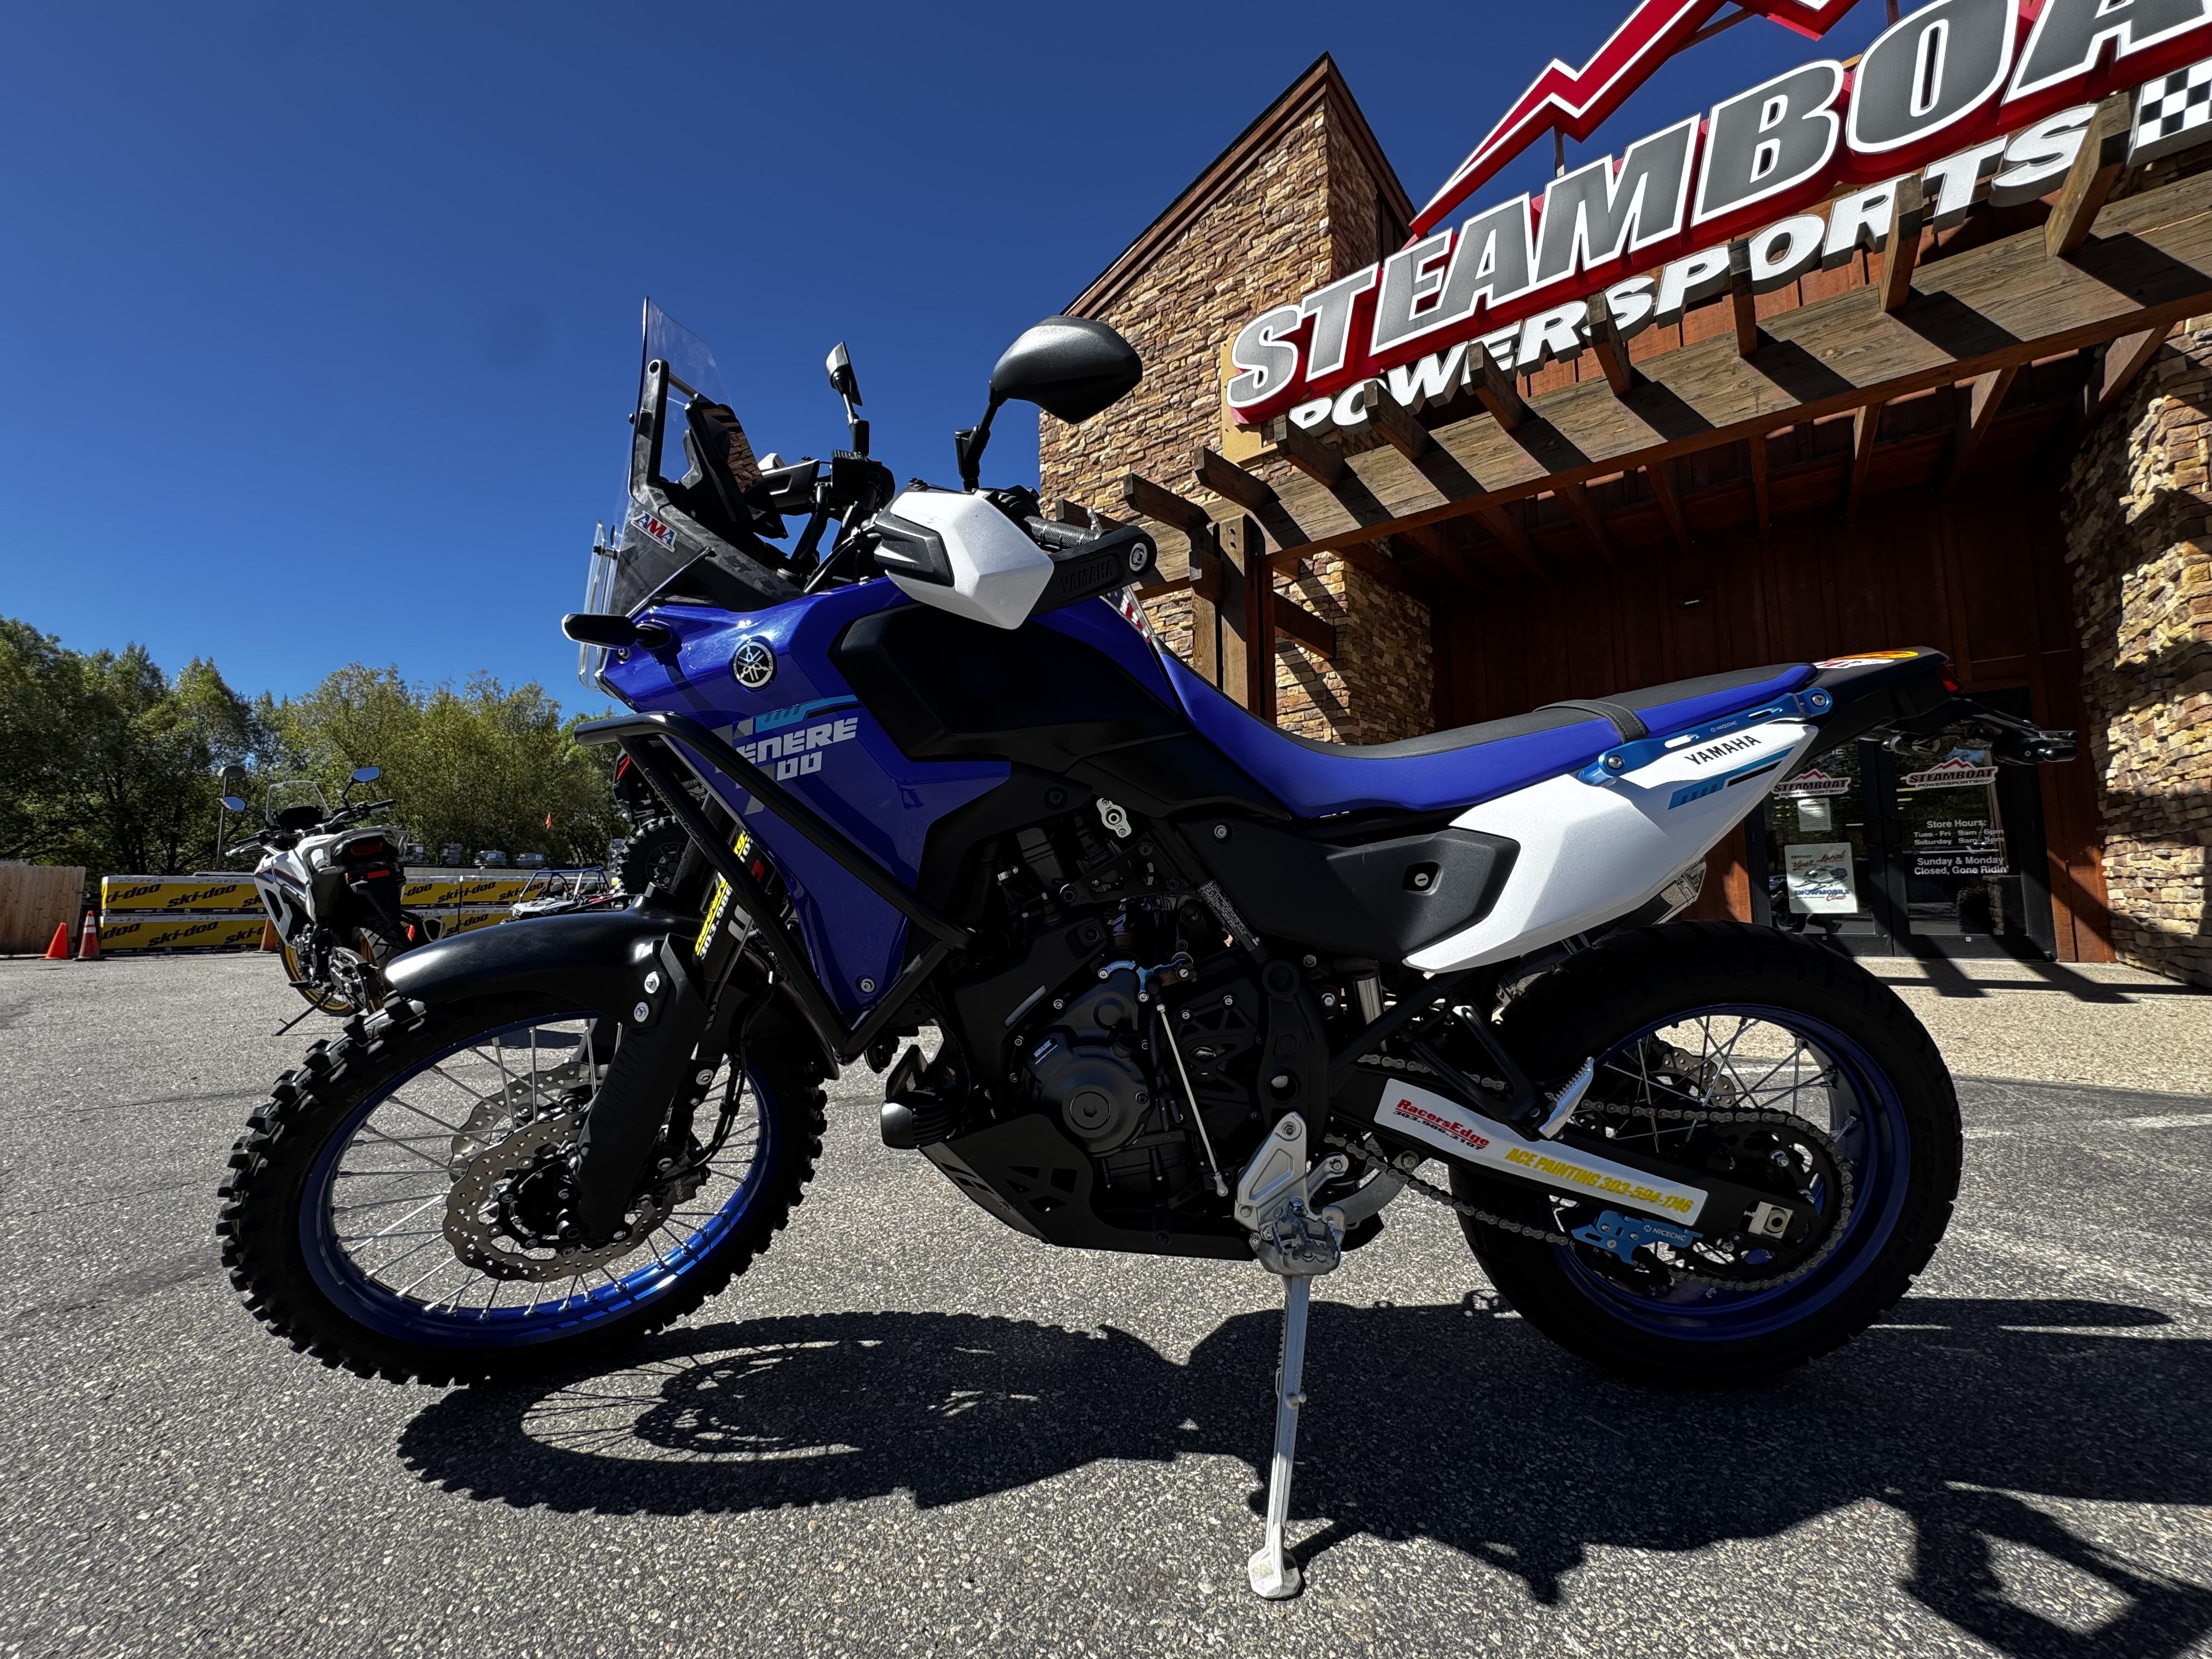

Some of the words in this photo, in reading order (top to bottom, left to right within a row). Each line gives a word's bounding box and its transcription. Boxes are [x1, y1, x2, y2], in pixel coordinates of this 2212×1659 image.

[633, 512, 674, 547] AMA
[1060, 560, 1113, 594] YAMAHA
[735, 717, 858, 764] ENERE
[1684, 735, 1762, 765] YAMAHA
[776, 751, 823, 781] 00
[1910, 768, 1996, 785] STEAMBOAT
[1774, 780, 1848, 793] STEAMBOAT
[1917, 780, 1979, 788] POWERSPORTS
[1914, 867, 1950, 875] Closed,
[1980, 865, 2009, 873] Ridin'
[1917, 857, 1953, 866] Sunday
[1965, 856, 2004, 865] Monday
[105, 884, 161, 904] ki-doo
[167, 884, 237, 907] ski-doo
[147, 922, 218, 947] ski-doo
[1393, 1110, 1486, 1150] 303.986.2107
[1396, 1099, 1489, 1147] RacersEdge
[674, 1178, 684, 1200] embo
[1504, 1148, 1538, 1167] ACE
[1533, 1158, 1602, 1186] PAINTING
[1598, 1177, 1694, 1214] 303-594-1746
[1652, 1227, 1686, 1242] NICECNC
